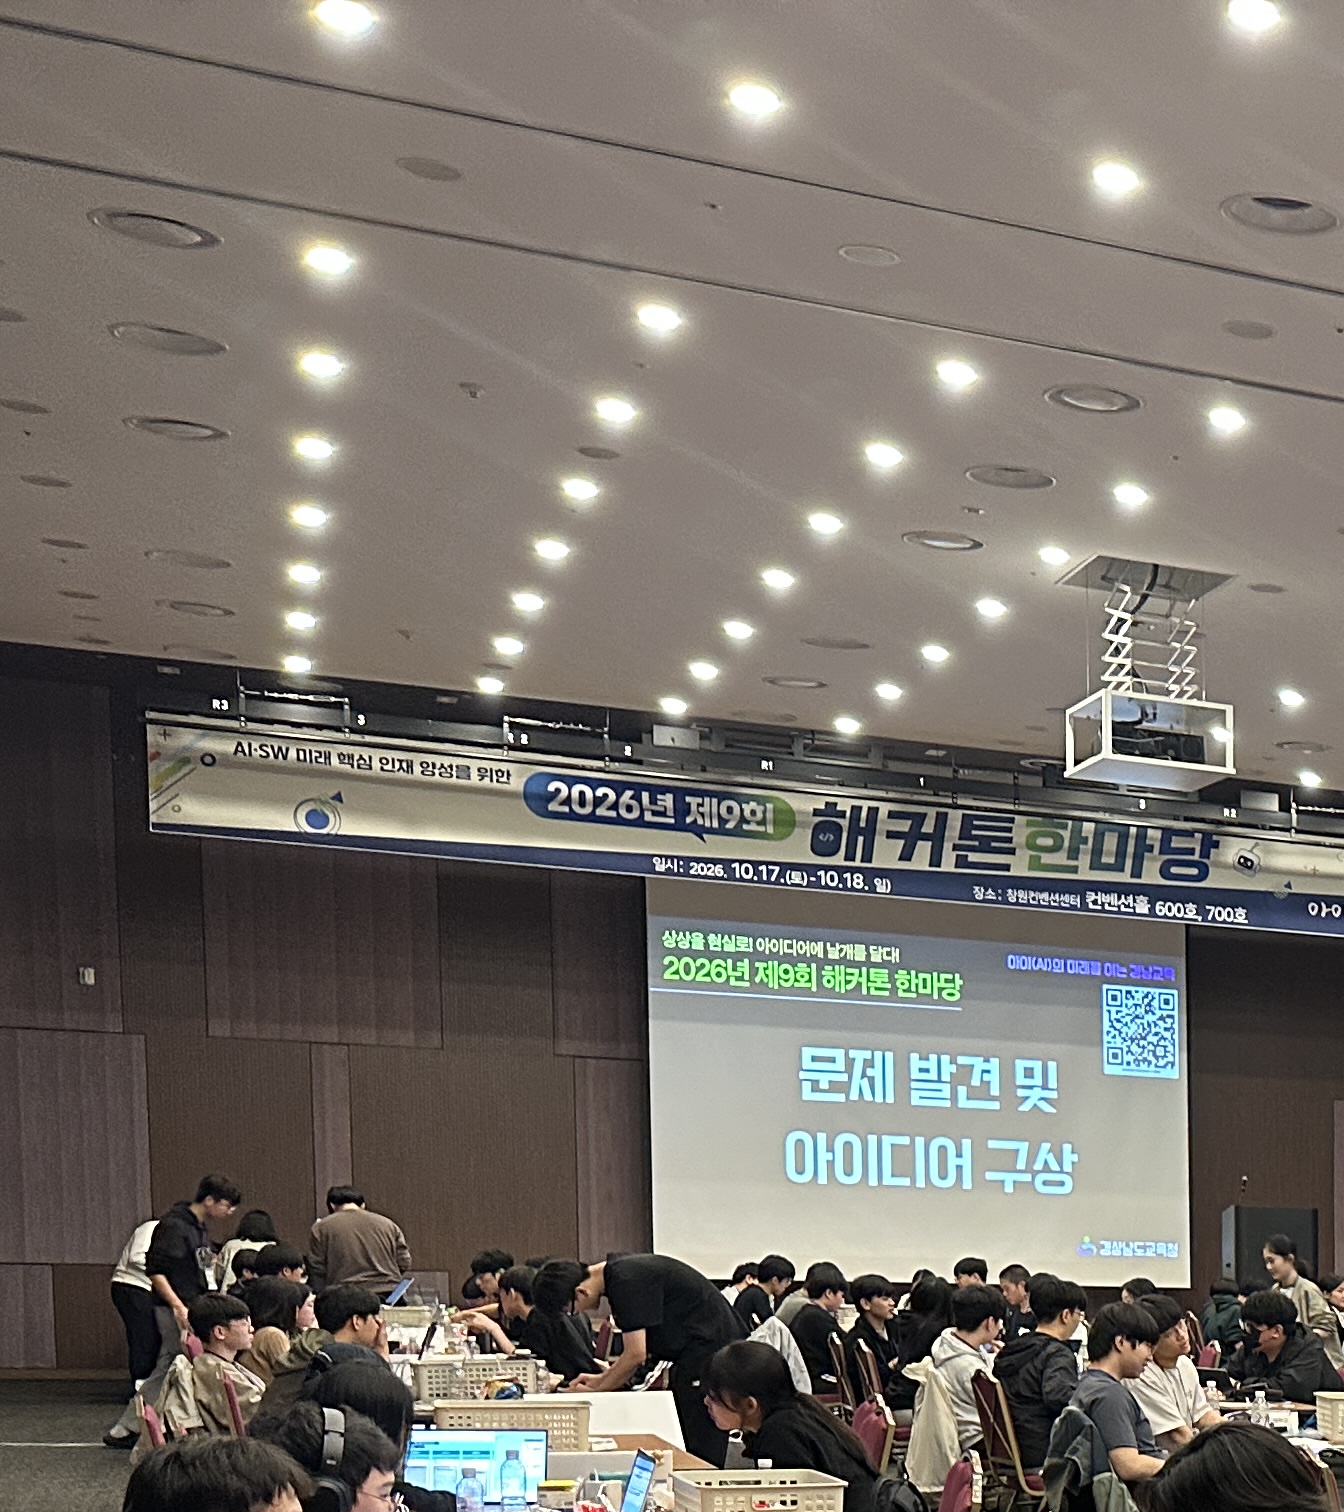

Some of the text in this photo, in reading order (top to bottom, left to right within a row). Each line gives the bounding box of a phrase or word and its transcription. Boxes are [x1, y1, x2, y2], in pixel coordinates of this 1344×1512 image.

[233, 740, 512, 785] AI·SW 미래 핵심 인재 양성을 위한
[547, 780, 774, 834] 2026년 제9회
[652, 856, 685, 874] 일시:
[689, 861, 728, 879] 2026.
[972, 885, 1248, 925] 장소: 창원컨벤션센터 컨벤션홀 600호, 700호
[662, 930, 899, 963] 상상을 현실로! 아이디어에 날개를 달다!
[663, 955, 963, 1001] 2026년 제9회 해커톤 한마당
[799, 1046, 1058, 1114] 문제 발견 및
[784, 1130, 1079, 1195] 아이디어 구상
[1099, 1240, 1179, 1258] 경상남도교육청
